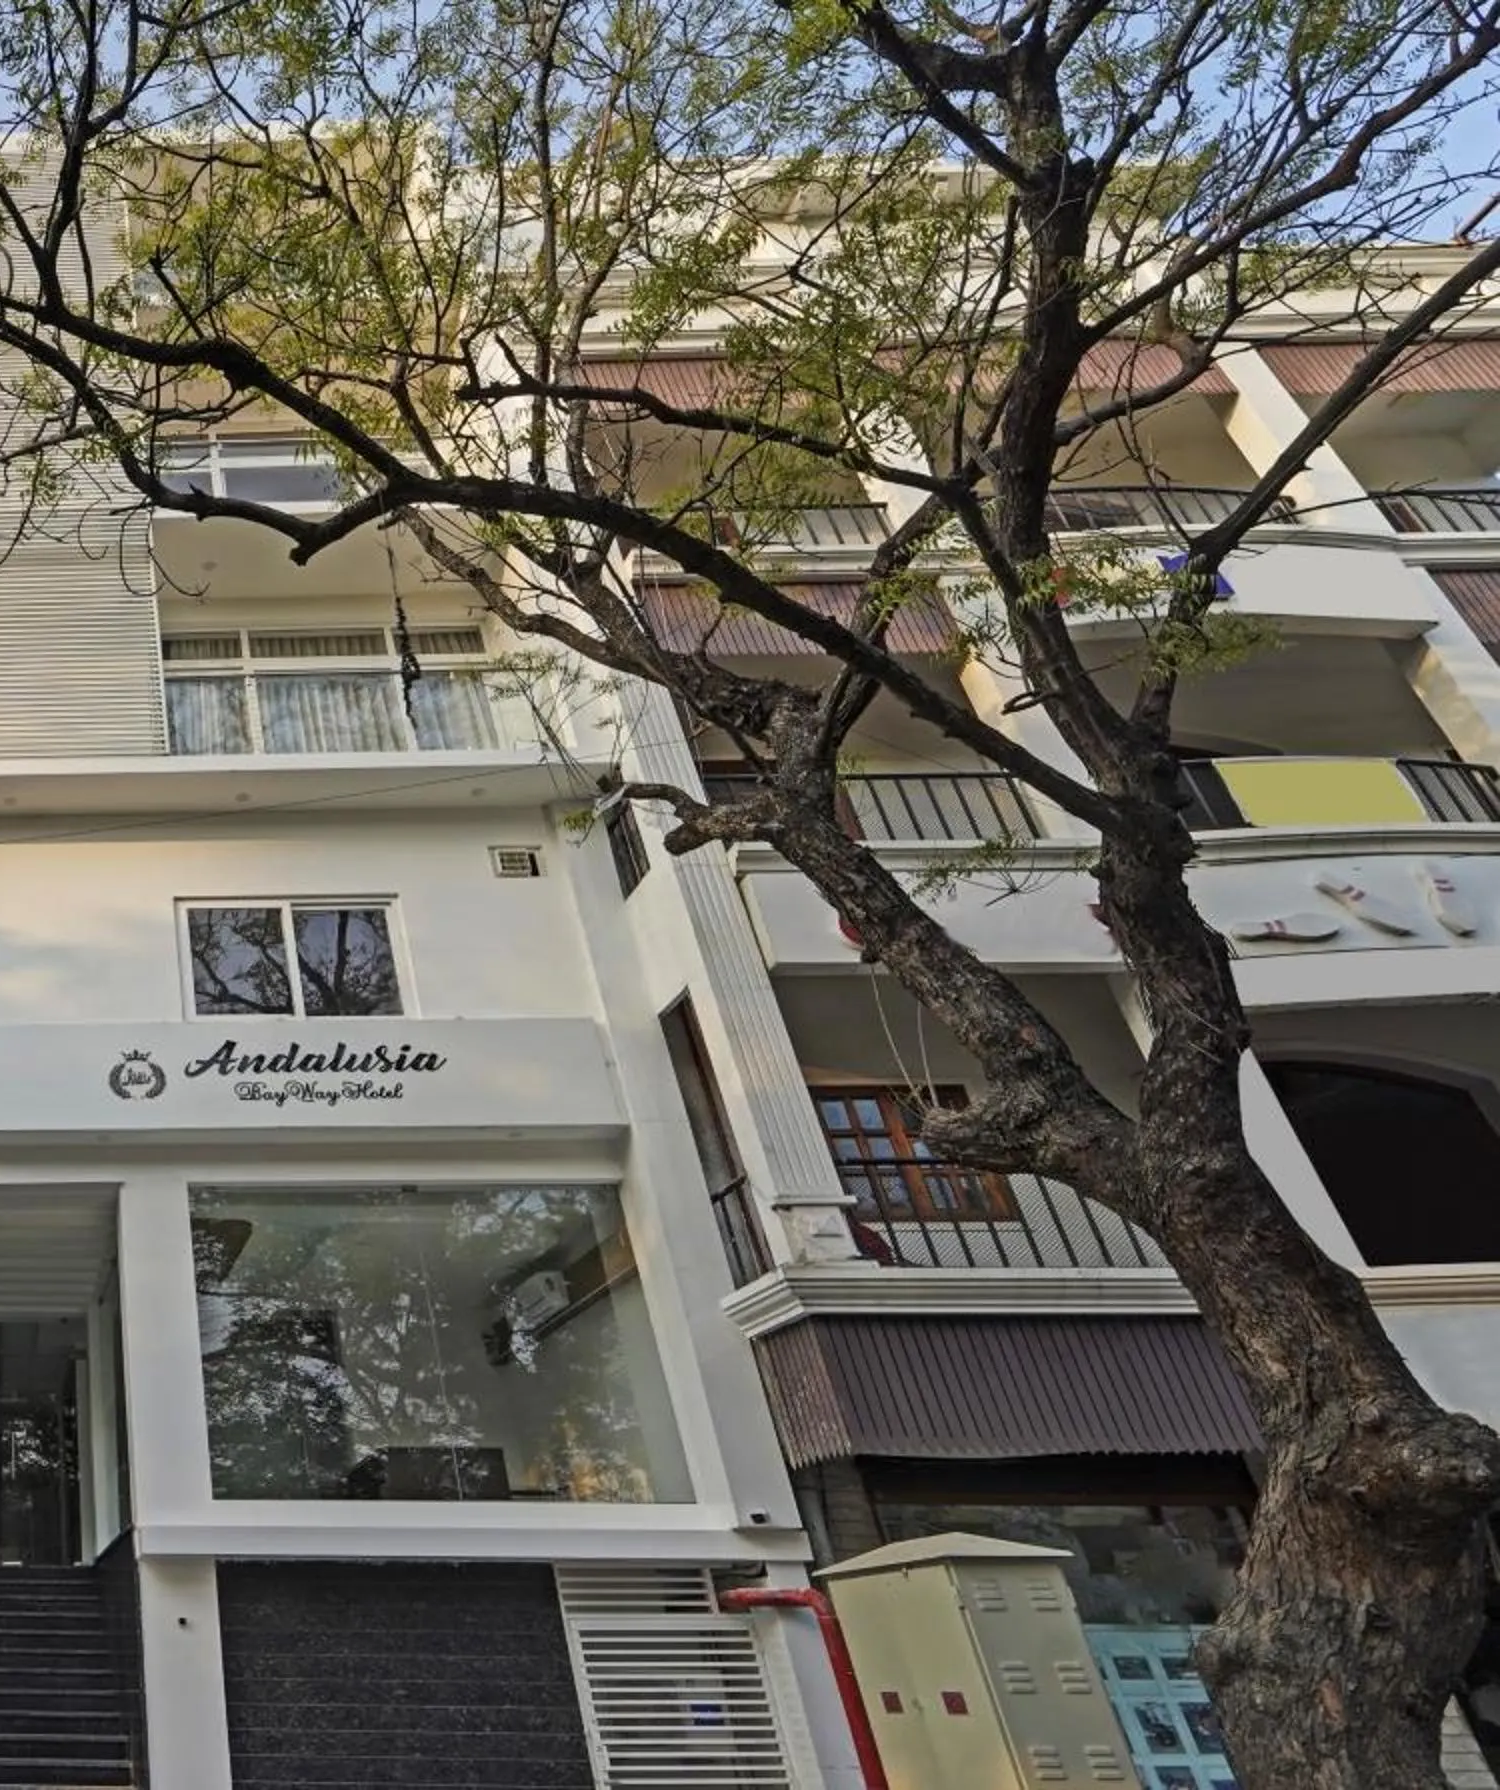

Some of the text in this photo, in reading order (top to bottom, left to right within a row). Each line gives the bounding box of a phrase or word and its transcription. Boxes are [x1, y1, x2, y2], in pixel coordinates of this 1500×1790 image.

[184, 1039, 448, 1078] Andalusia
[234, 1080, 404, 1107] Bay Way Hotel
